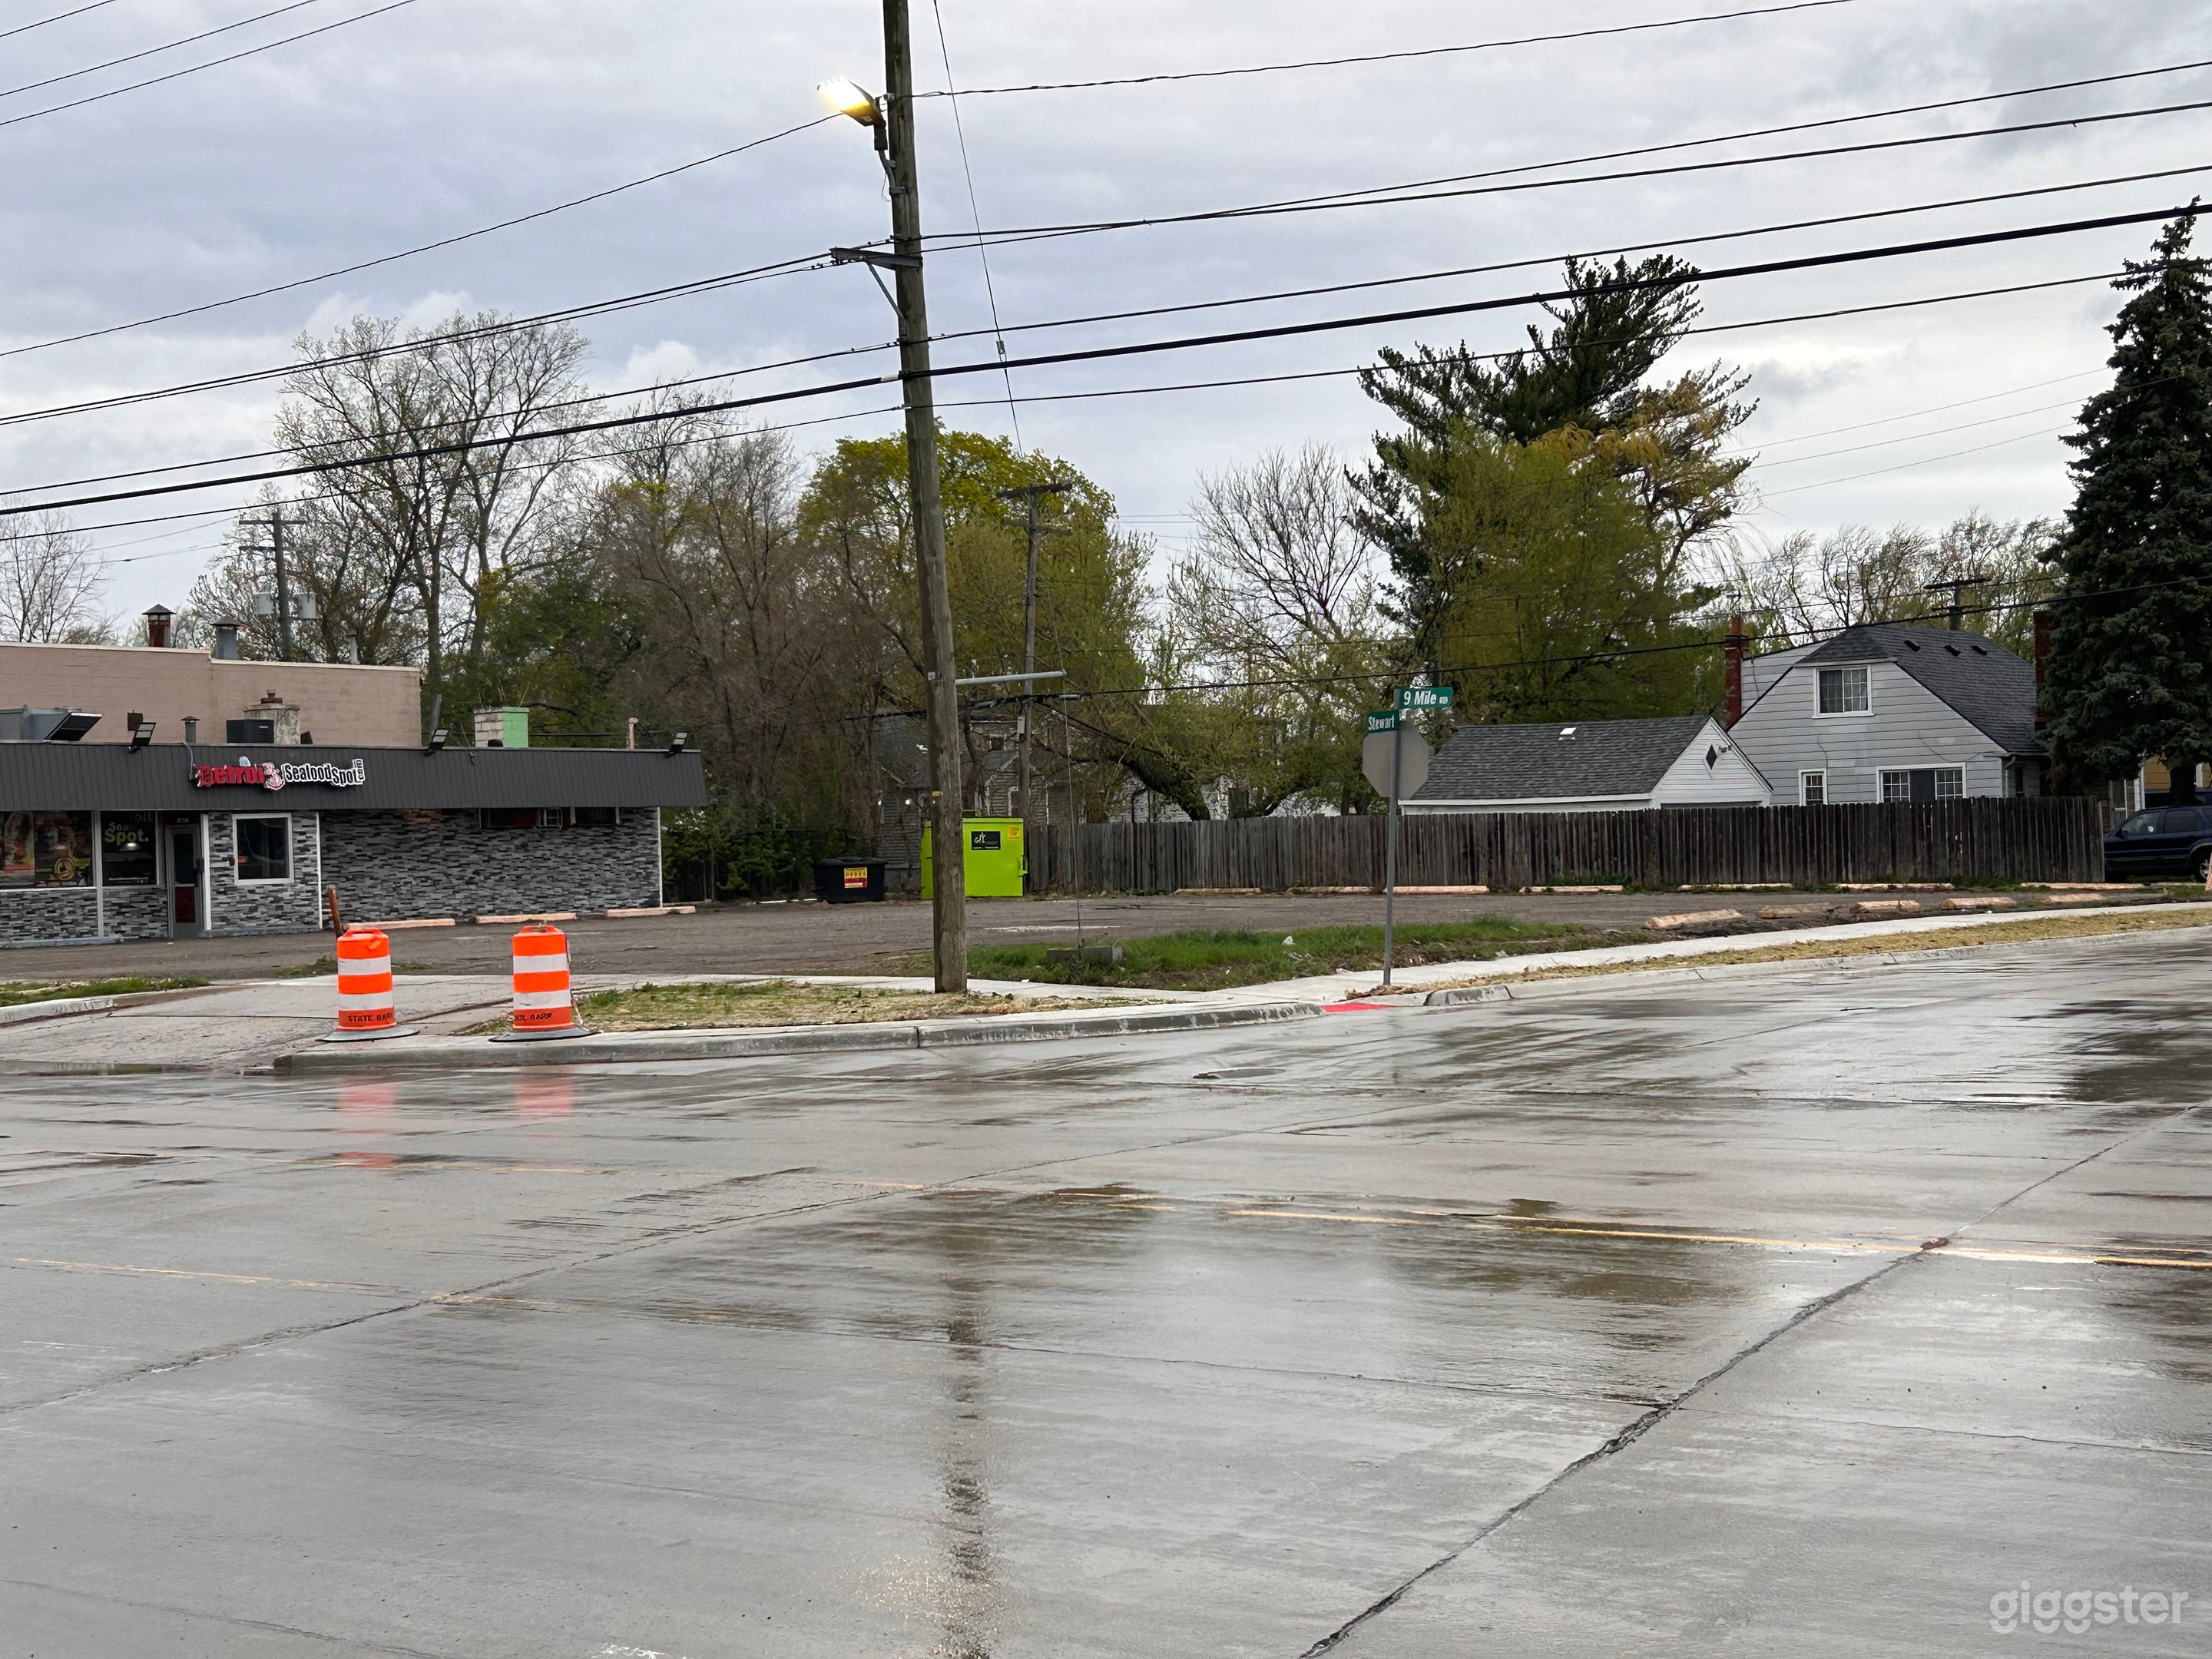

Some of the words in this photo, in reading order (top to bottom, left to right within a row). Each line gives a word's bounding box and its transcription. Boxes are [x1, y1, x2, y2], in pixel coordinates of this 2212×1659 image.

[1403, 690, 1412, 706] 9
[1414, 690, 1437, 705] Mile
[1368, 714, 1395, 730] Stewart
